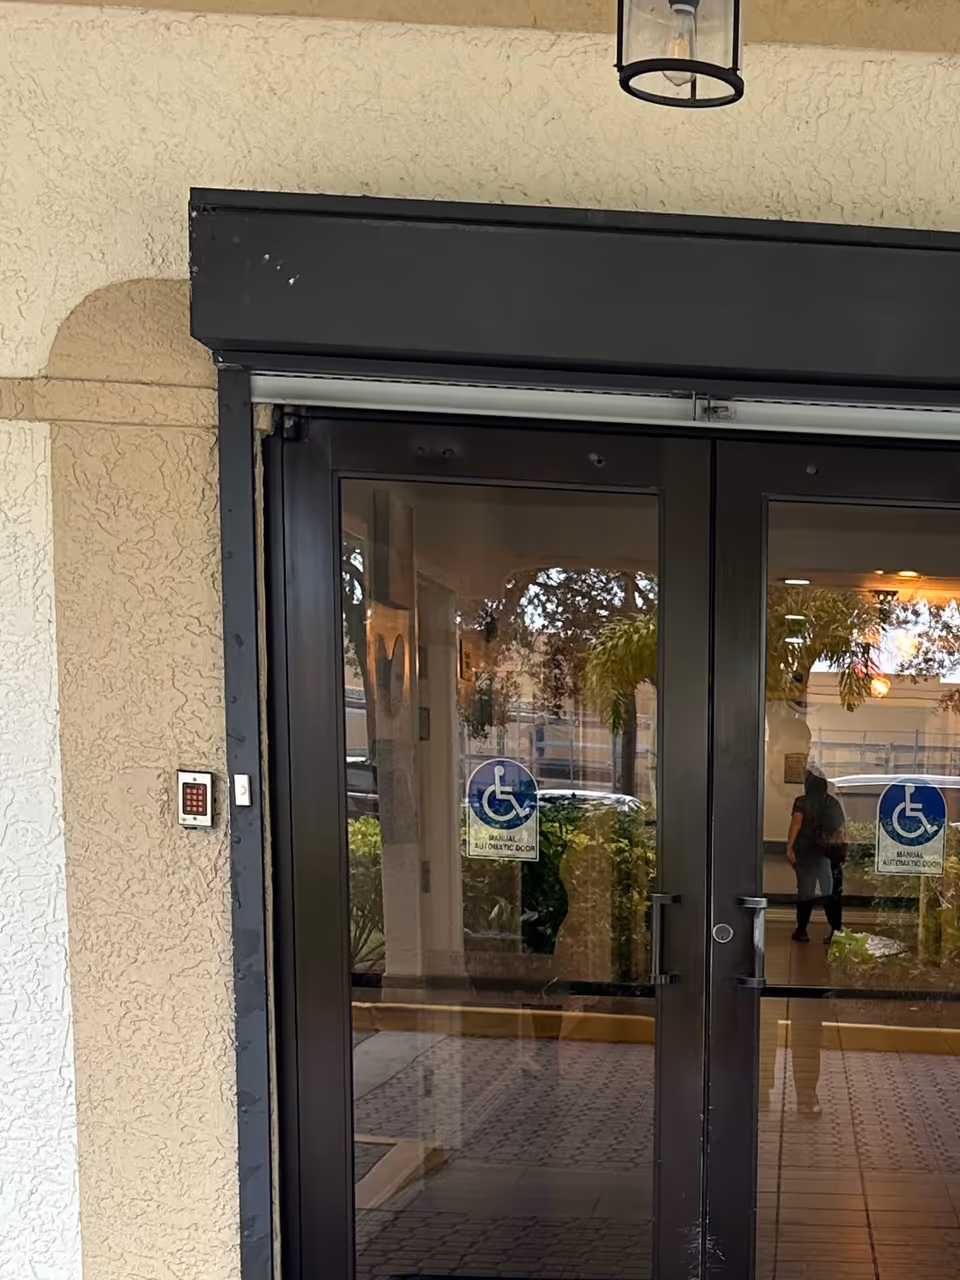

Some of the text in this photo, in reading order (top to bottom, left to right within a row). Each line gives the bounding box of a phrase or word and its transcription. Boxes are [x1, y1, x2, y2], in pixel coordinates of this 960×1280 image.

[474, 843, 513, 851] AUTOMATIC
[883, 859, 942, 869] AUTOMATIC DOOR
